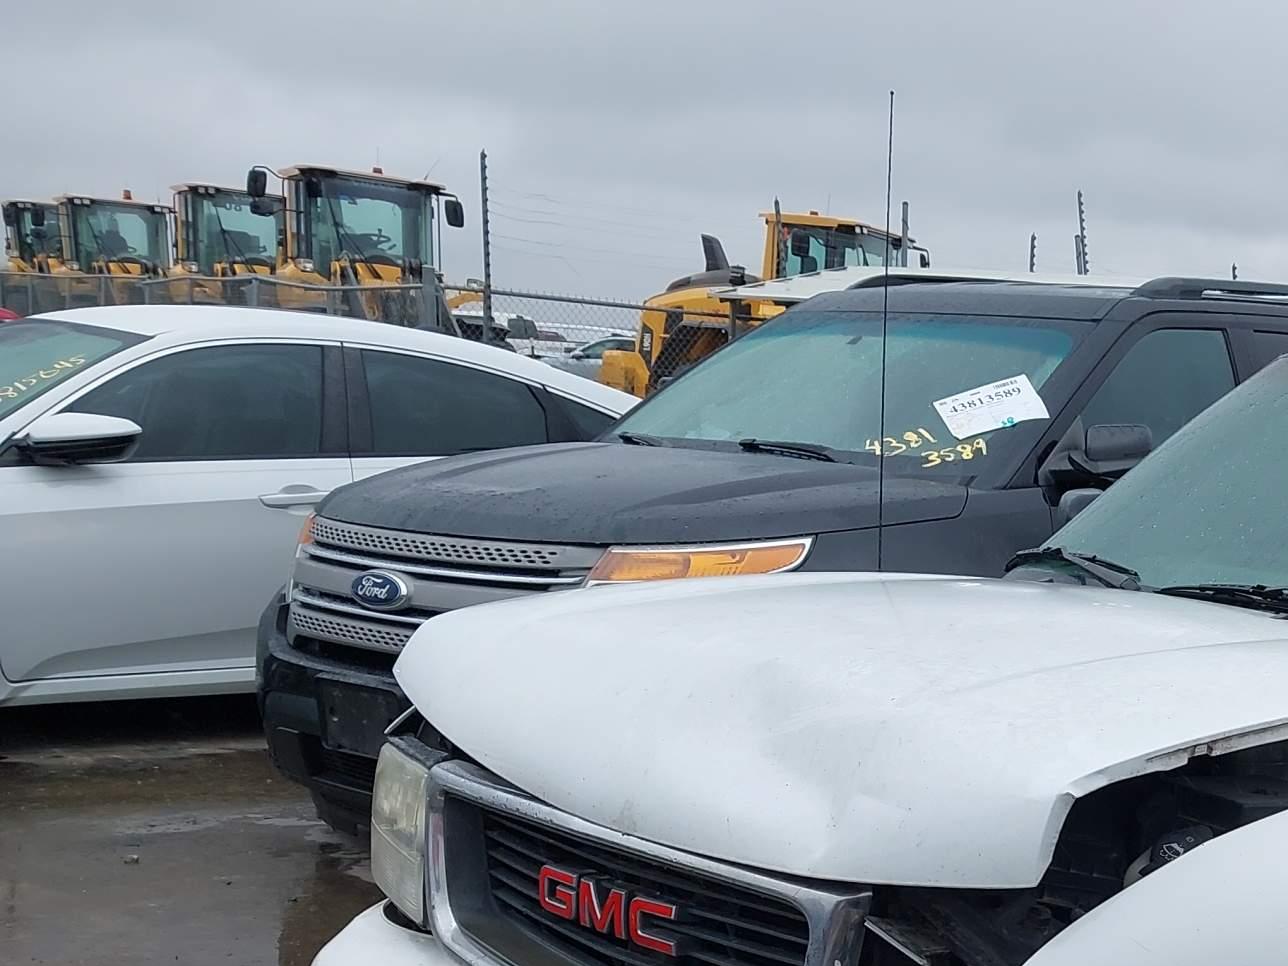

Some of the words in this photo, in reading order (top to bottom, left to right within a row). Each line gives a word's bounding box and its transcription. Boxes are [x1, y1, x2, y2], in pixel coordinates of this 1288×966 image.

[949, 386, 1021, 413] 43813589
[865, 428, 938, 457] 4381
[921, 438, 988, 467] 3589
[358, 576, 390, 599] Ford
[538, 864, 677, 957] GMC
